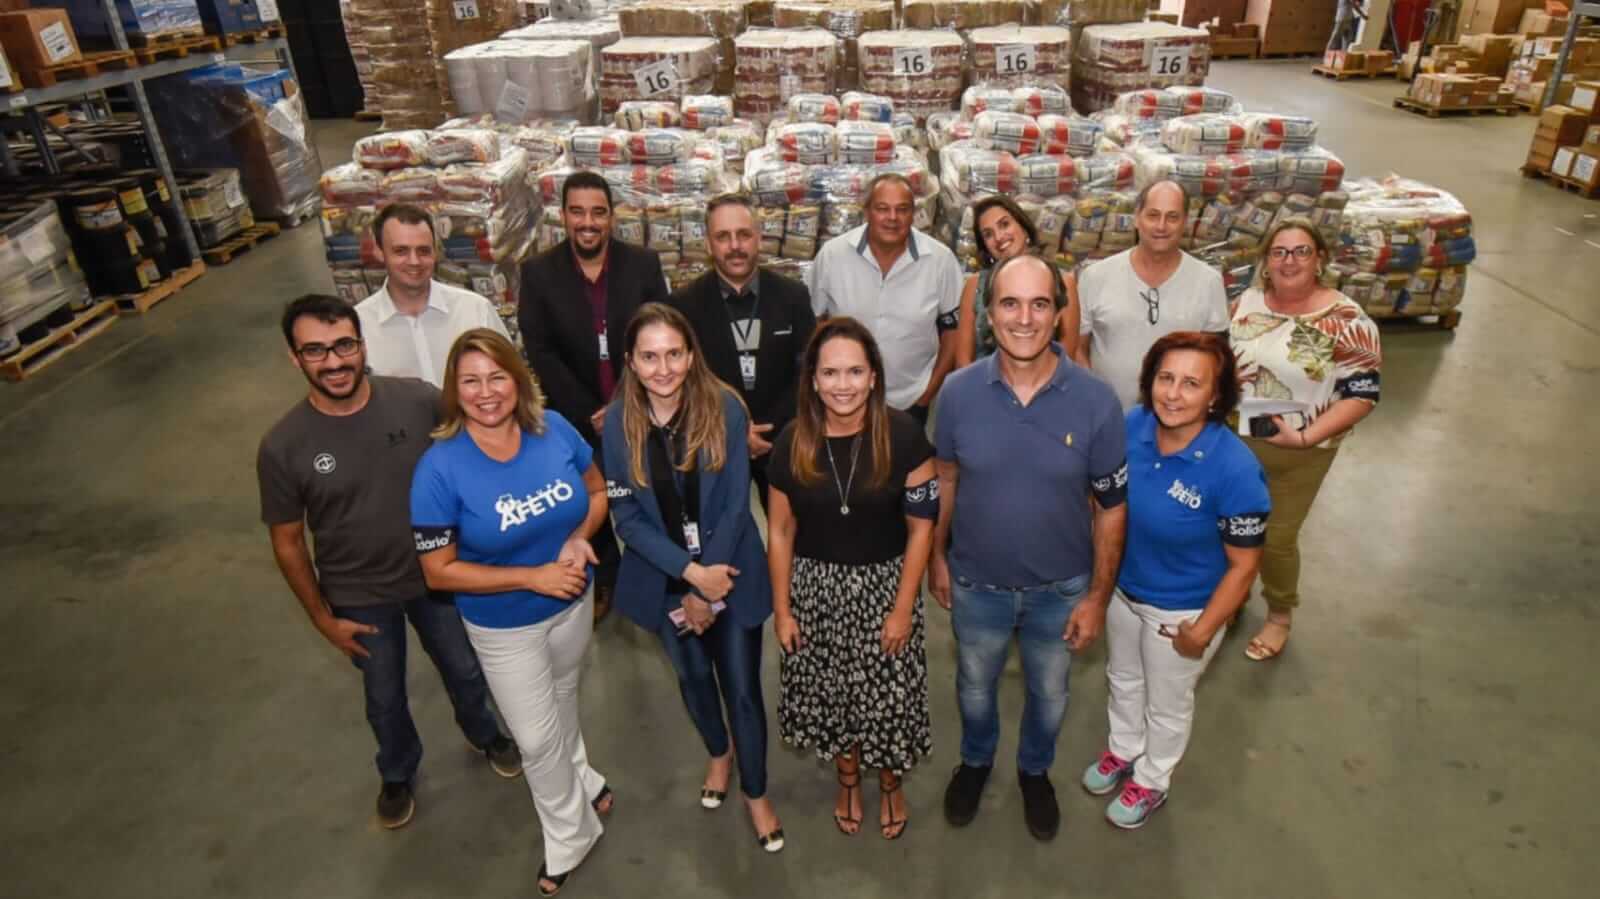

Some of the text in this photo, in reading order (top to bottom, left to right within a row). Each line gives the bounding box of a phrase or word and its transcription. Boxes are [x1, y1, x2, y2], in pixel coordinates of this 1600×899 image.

[459, 7, 474, 17] 16
[902, 55, 925, 73] 16
[1003, 53, 1028, 72] 16
[1157, 56, 1181, 74] 16
[645, 71, 670, 93] 16
[499, 480, 573, 531] AFETO
[1230, 516, 1261, 525] Clube
